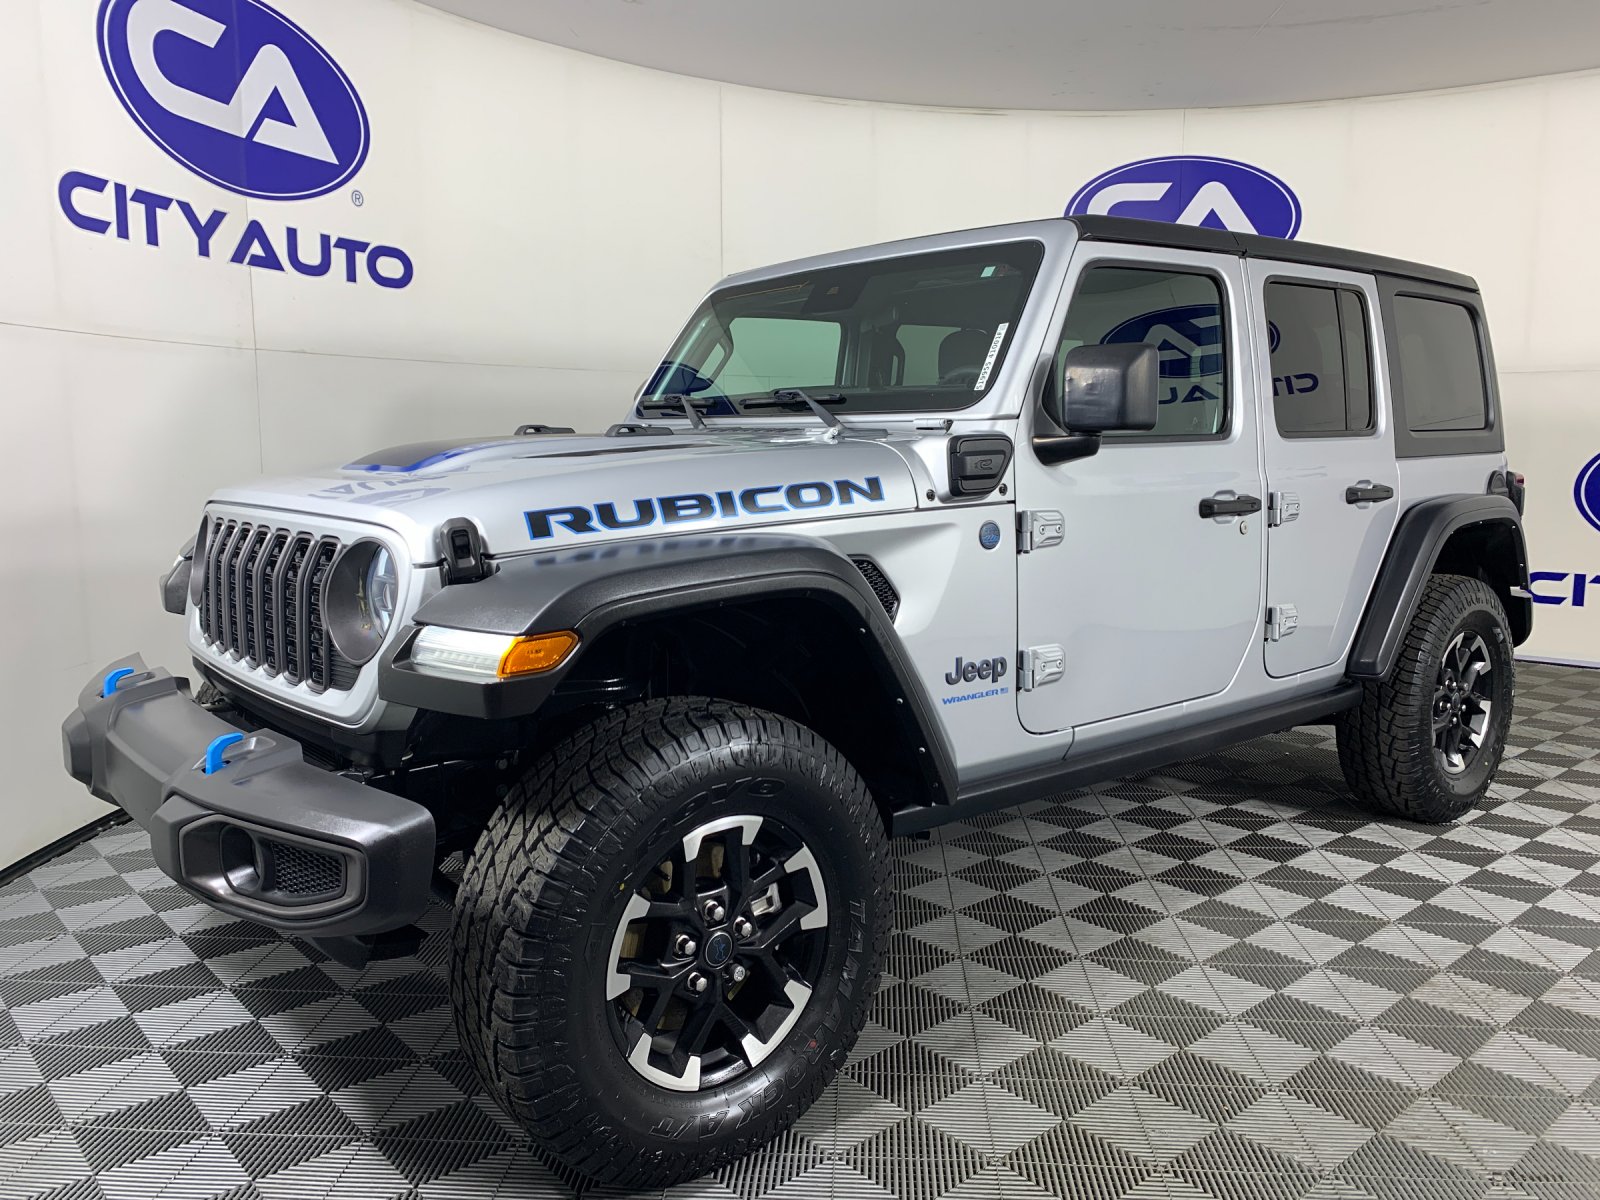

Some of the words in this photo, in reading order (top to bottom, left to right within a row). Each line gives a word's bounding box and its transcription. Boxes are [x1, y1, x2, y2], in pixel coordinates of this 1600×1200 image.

[126, 0, 339, 165] CA
[58, 171, 227, 258] CITY
[230, 220, 413, 289] AUTO
[524, 475, 885, 540] RUBICON
[1529, 571, 1600, 607] CI
[945, 655, 1007, 686] Jeep
[942, 689, 999, 705] WRANGLER
